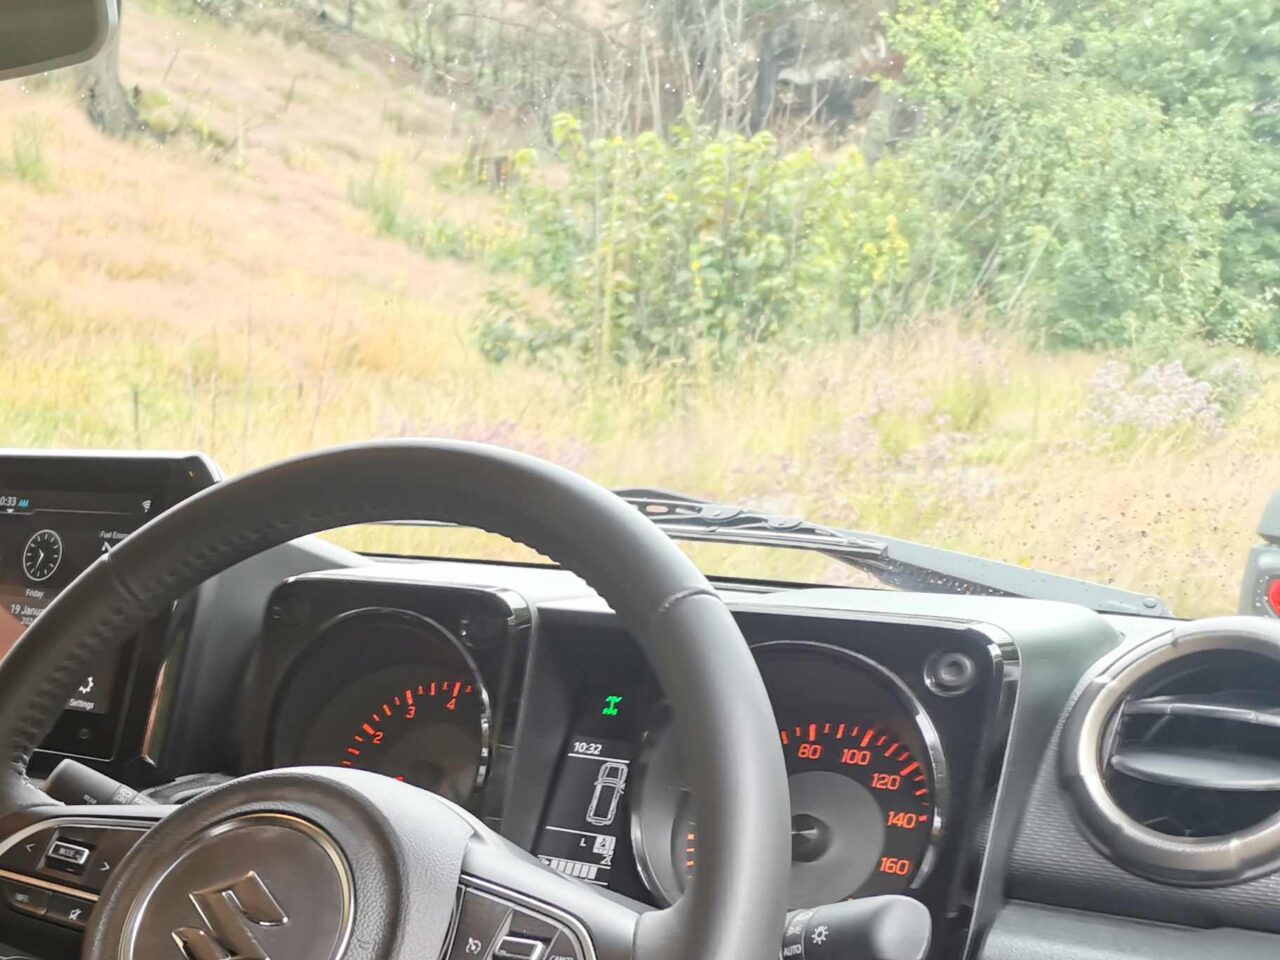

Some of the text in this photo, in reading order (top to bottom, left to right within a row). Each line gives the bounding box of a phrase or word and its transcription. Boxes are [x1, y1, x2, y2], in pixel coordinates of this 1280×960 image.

[18, 499, 30, 507] AM
[100, 530, 112, 538] Fuel
[25, 589, 45, 599] Friday
[11, 604, 21, 614] 19
[70, 698, 95, 710] Settings
[446, 698, 456, 710] 4
[405, 706, 416, 718] 3
[372, 732, 384, 744] 2
[573, 742, 603, 755] 10:32
[797, 743, 822, 759] 80
[840, 748, 871, 766] 100
[871, 772, 901, 790] 120
[887, 811, 916, 828] 140
[880, 857, 910, 875] 160
[783, 944, 802, 957] AUTO
